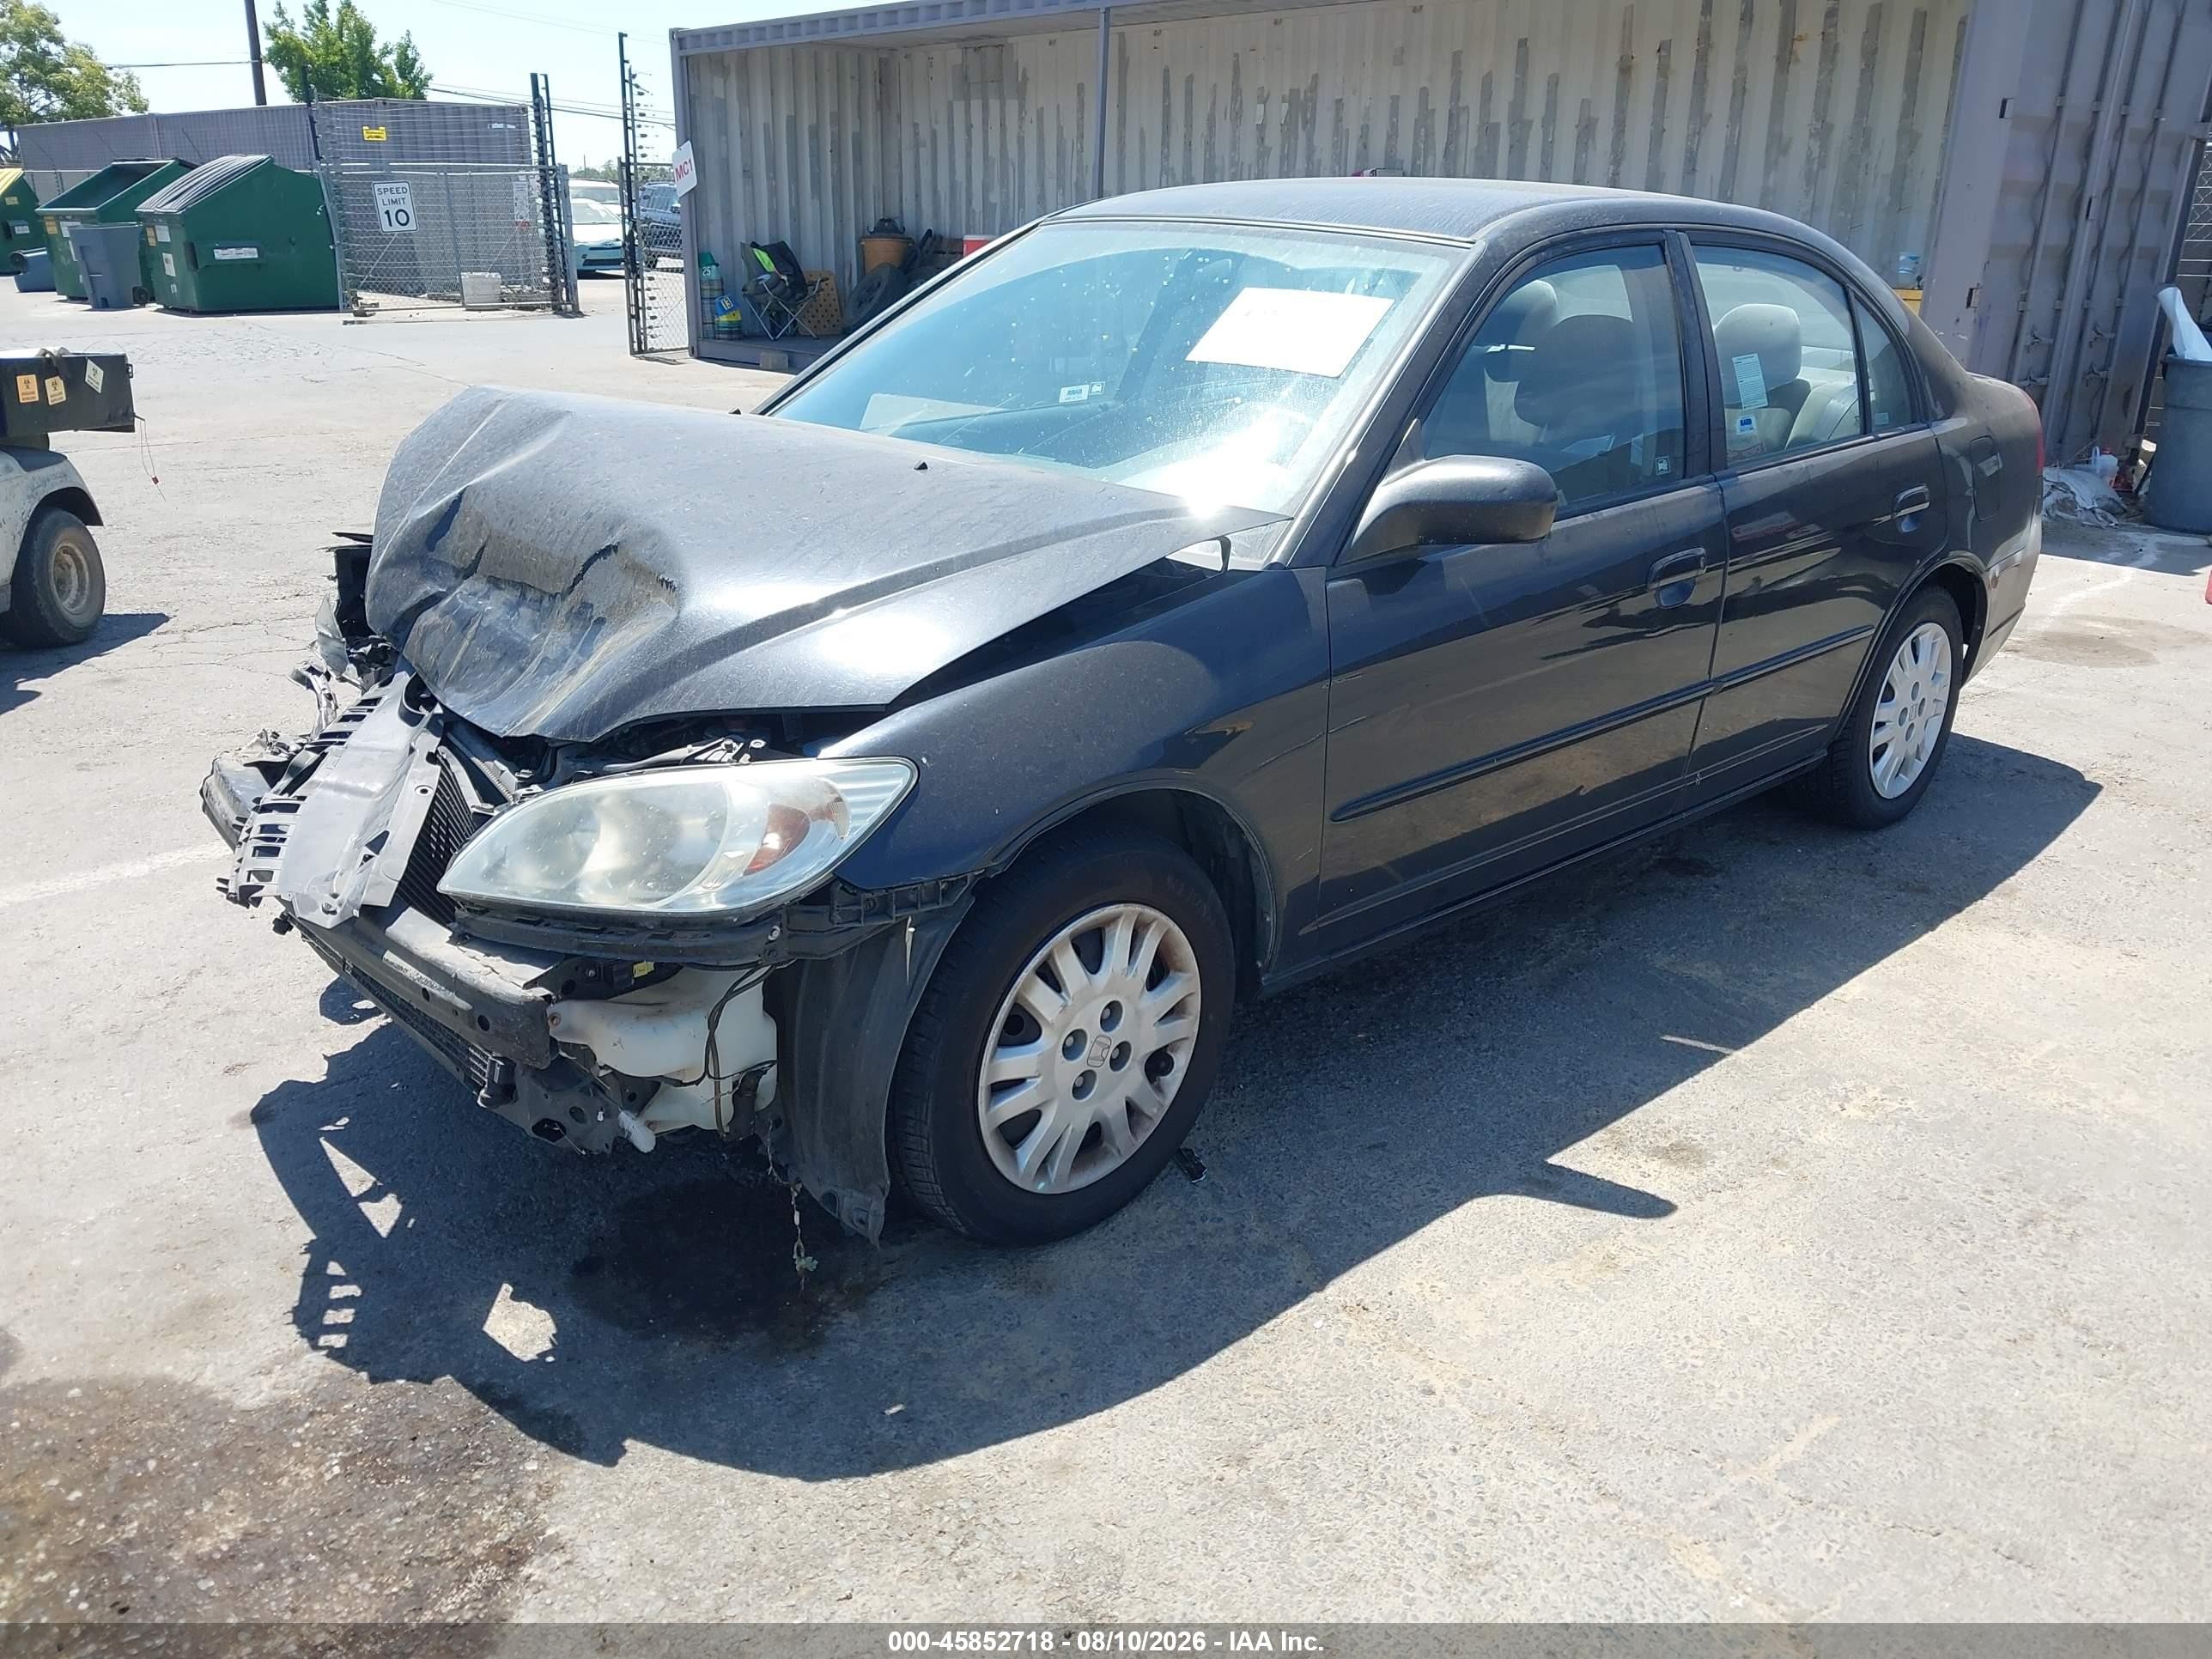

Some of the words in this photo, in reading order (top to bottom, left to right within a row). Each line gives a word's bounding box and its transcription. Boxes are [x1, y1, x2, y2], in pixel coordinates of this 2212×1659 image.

[675, 158, 693, 182] MC1
[377, 186, 408, 195] SPEED
[382, 198, 405, 206] LIMIT
[384, 209, 410, 228] 10
[702, 266, 711, 276] 25
